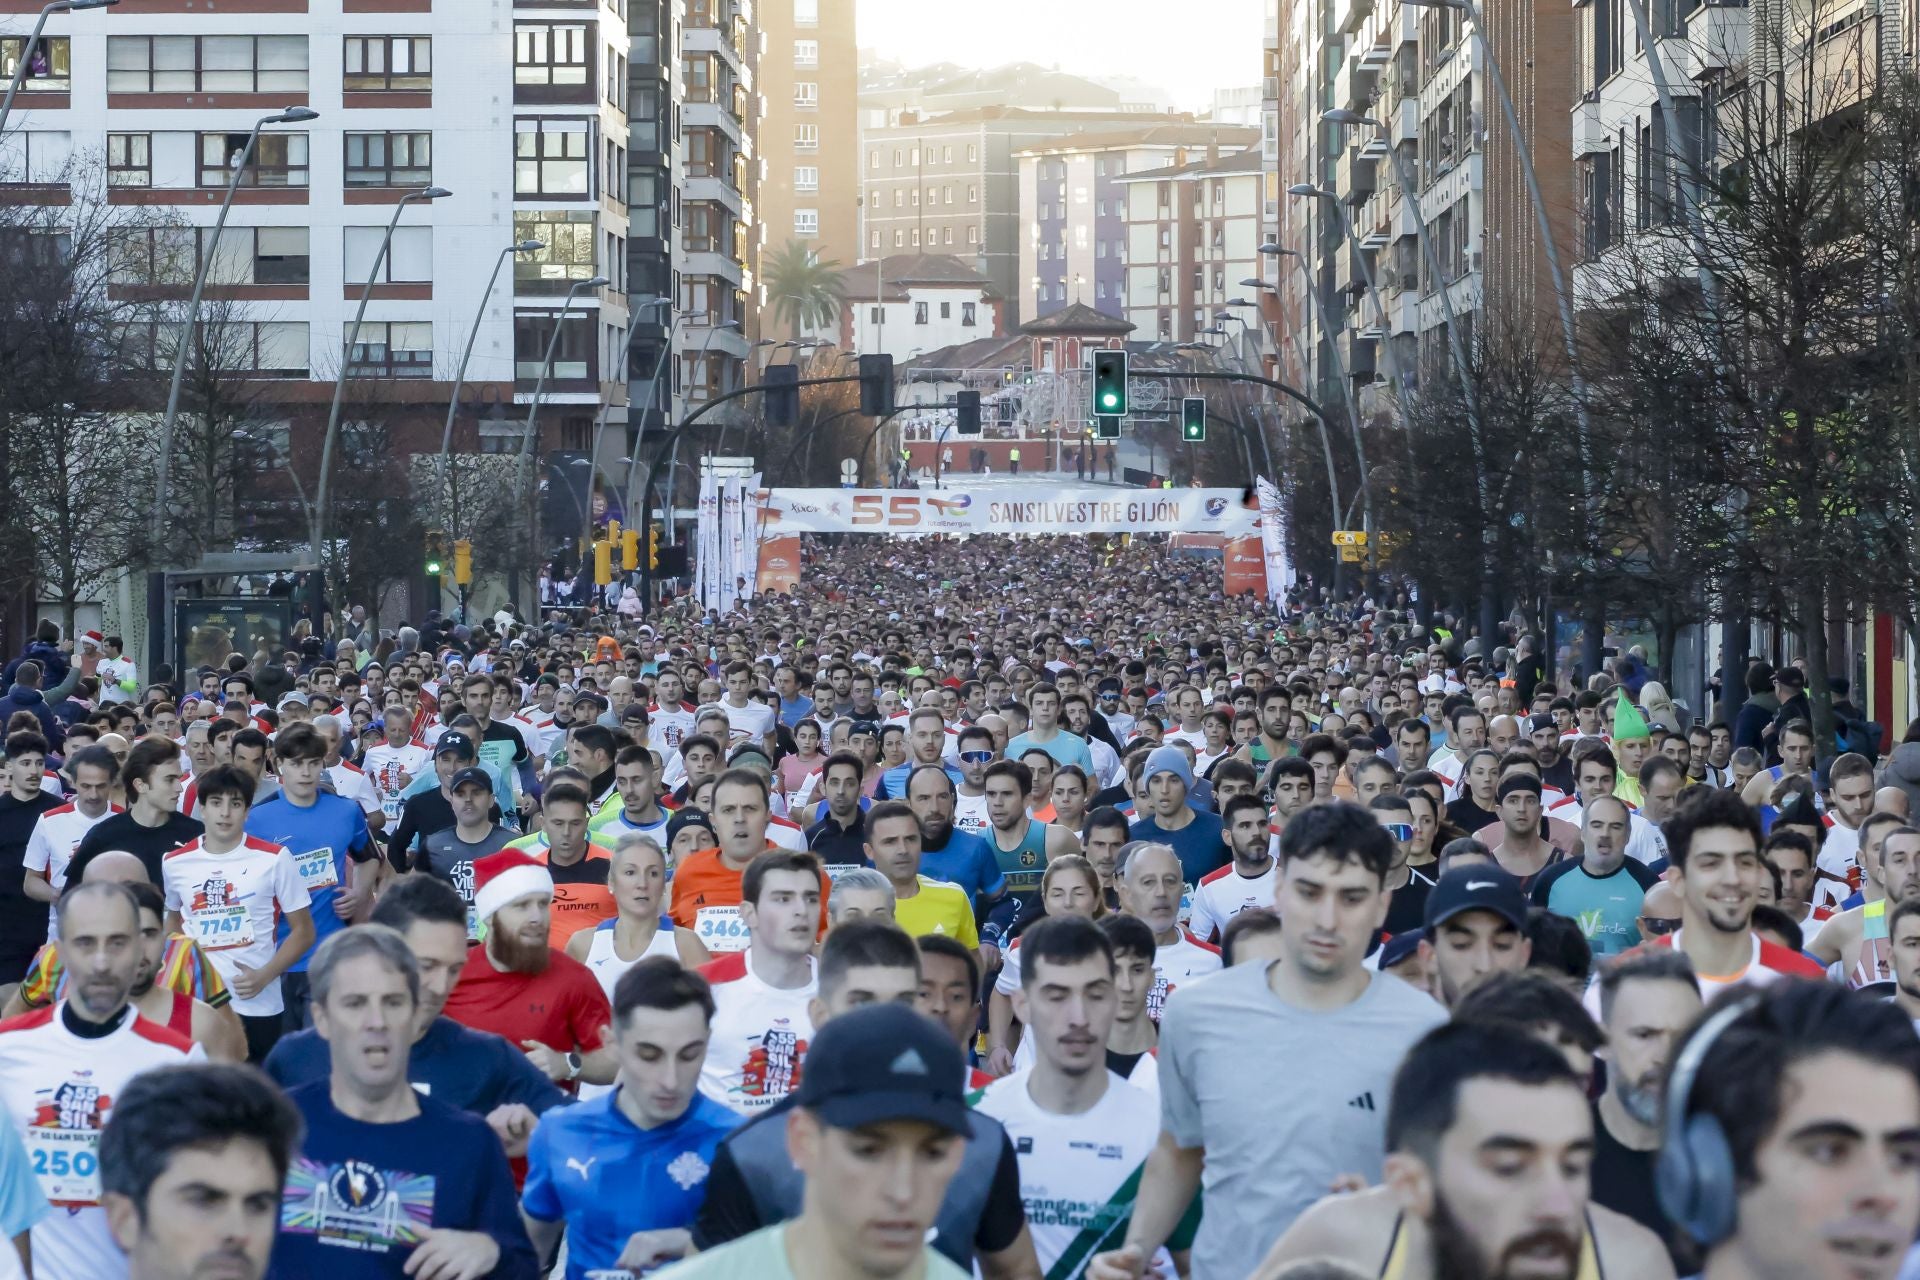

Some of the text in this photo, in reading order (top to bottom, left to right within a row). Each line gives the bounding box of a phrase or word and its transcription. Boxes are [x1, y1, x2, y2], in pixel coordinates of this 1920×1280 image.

[852, 495, 921, 526] 55
[989, 498, 1180, 523] SANSILVESTRE GIJÓN
[299, 859, 327, 878] 427
[449, 861, 475, 878] 45
[557, 901, 599, 912] runners
[200, 916, 242, 935] 7747
[1581, 911, 1627, 937] Verde
[768, 1053, 792, 1069] SIL
[763, 1078, 790, 1094] TRE
[60, 1110, 93, 1130] SIL
[33, 1148, 97, 1177] 250
